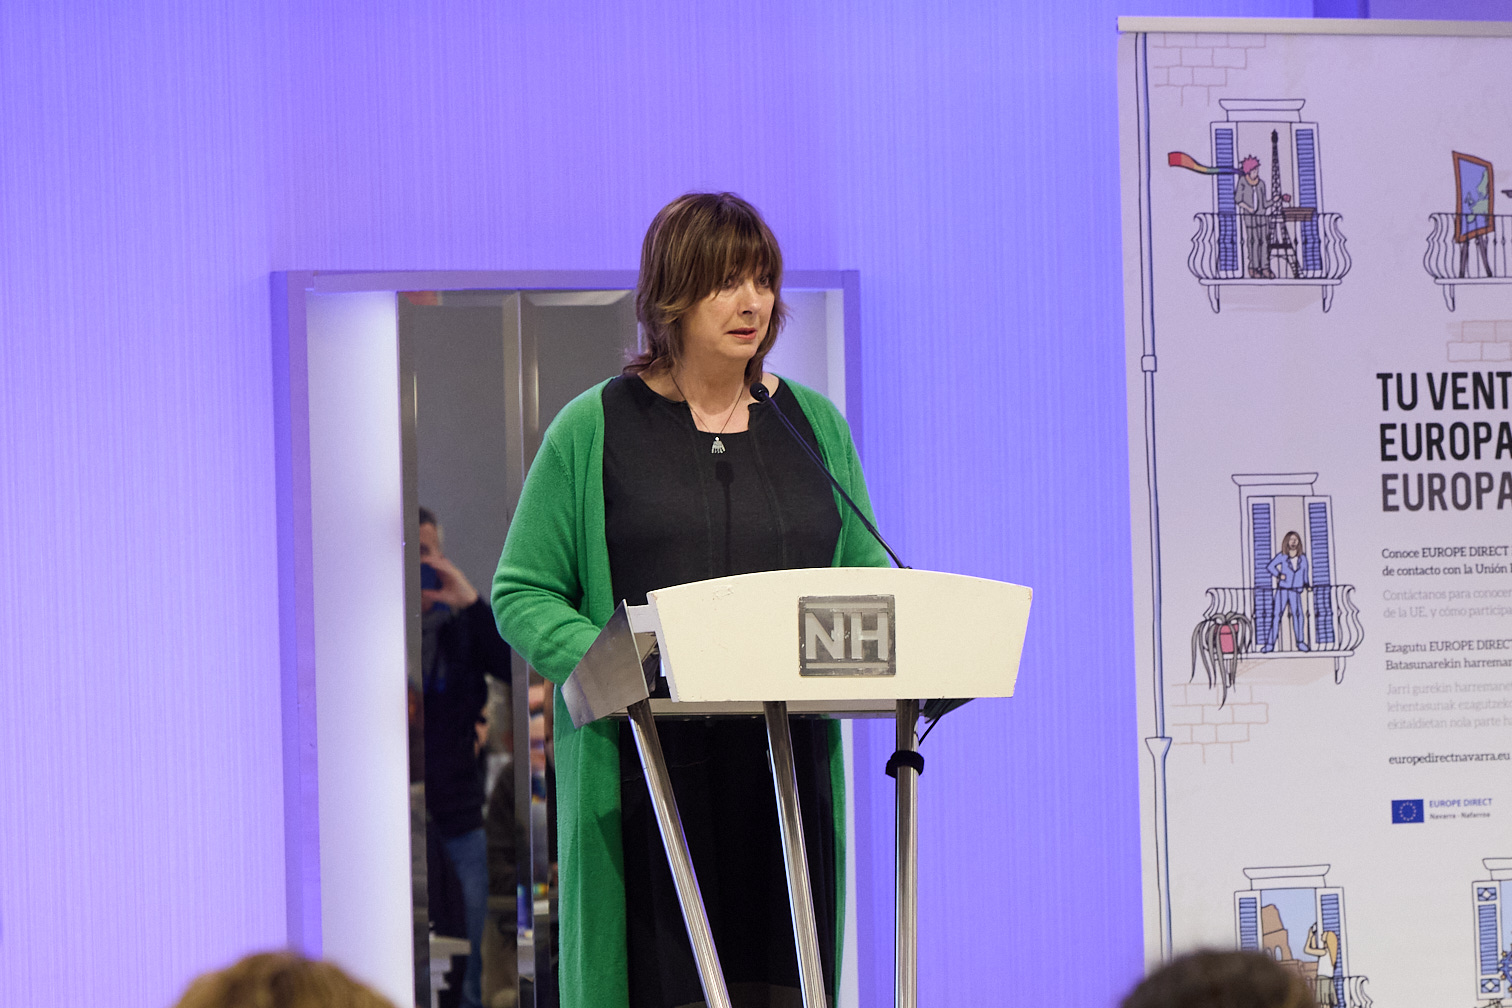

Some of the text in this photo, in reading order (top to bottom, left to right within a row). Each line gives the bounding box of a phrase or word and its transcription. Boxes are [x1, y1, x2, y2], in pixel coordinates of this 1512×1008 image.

[1377, 372, 1418, 411] TU
[1382, 548, 1419, 559] Conoce
[1421, 546, 1467, 558] EUROPE
[1469, 545, 1509, 557] DIRECT
[1382, 566, 1395, 576] de
[1396, 565, 1441, 576] contacto
[1443, 566, 1461, 575] con
[1464, 563, 1473, 574] la
[1475, 562, 1508, 574] Unión
[1383, 589, 1447, 601] Contáctanos
[1448, 590, 1472, 601] para
[1473, 588, 1512, 598] conocer
[1383, 608, 1396, 618] de
[1398, 606, 1407, 617] la
[1430, 608, 1437, 618] y
[804, 611, 889, 659] NH
[1385, 642, 1426, 654] Ezagutu
[1429, 640, 1474, 651] EUROPE
[1386, 658, 1461, 671] Batasunarekin
[1474, 716, 1501, 729] parte
[1388, 752, 1510, 766] europedirectnavarra.eu
[1429, 798, 1493, 808] EUROPE DIRECT
